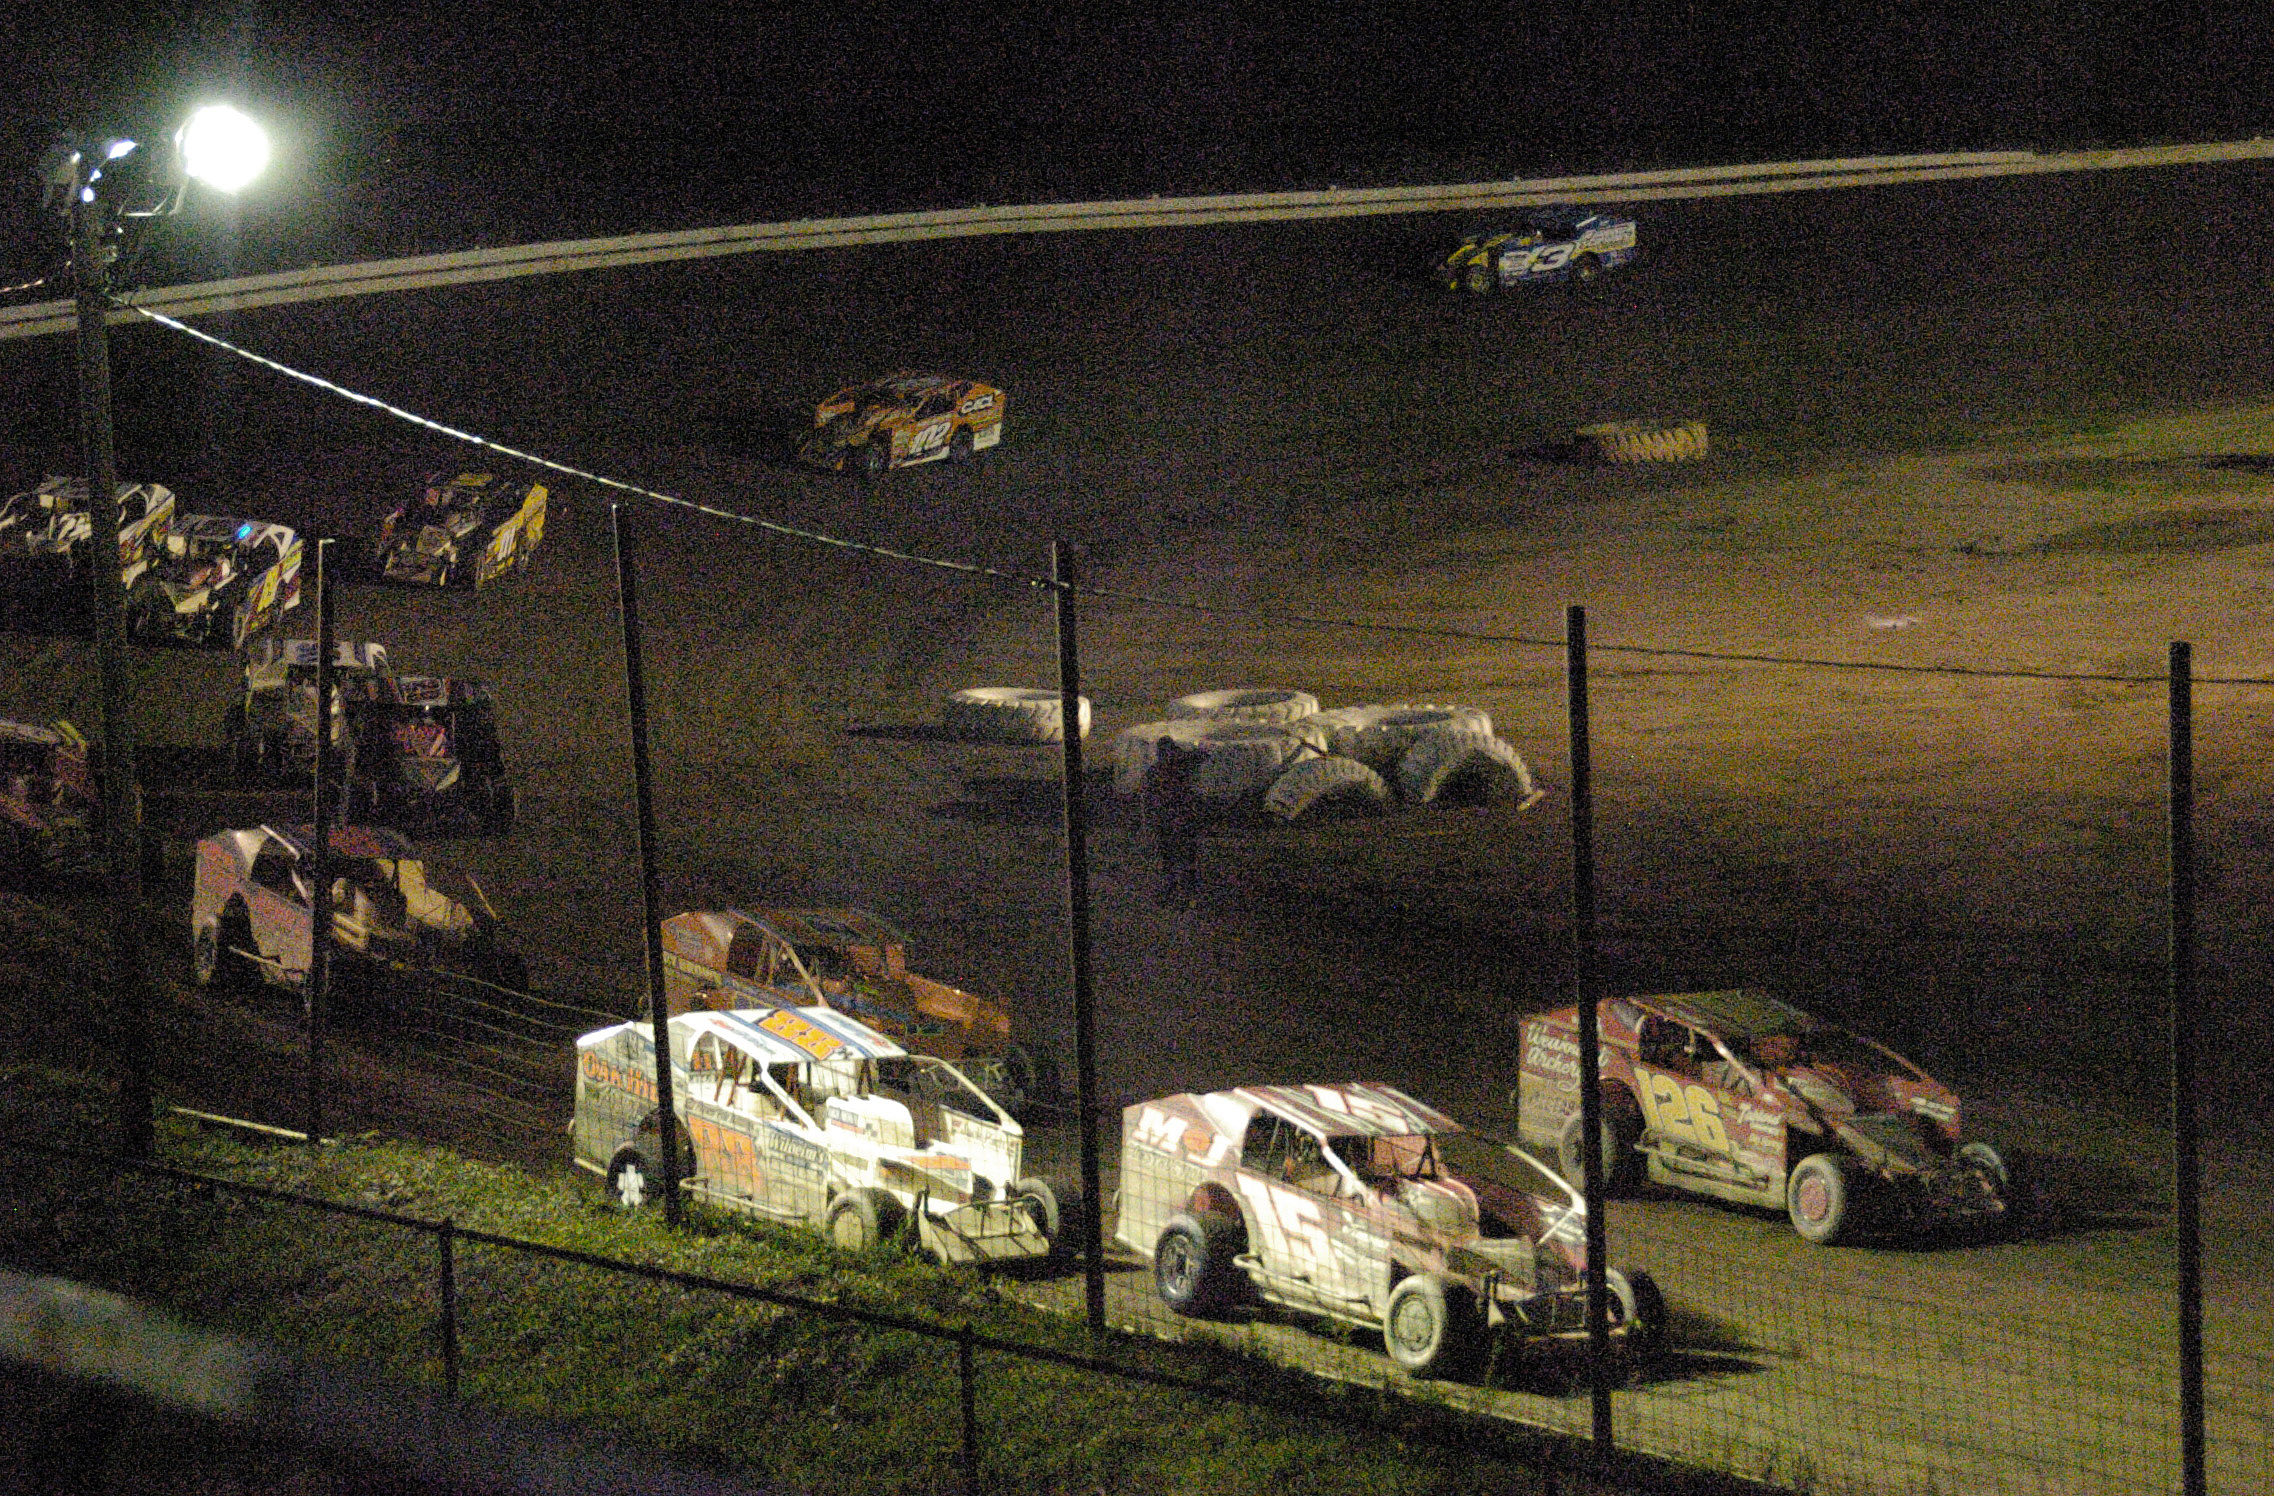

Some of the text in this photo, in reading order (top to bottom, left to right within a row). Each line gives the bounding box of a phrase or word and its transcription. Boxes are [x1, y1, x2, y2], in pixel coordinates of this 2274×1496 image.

[626, 1066, 660, 1104] HIL
[1634, 1067, 1730, 1153] 126
[1236, 1171, 1341, 1286] 15
